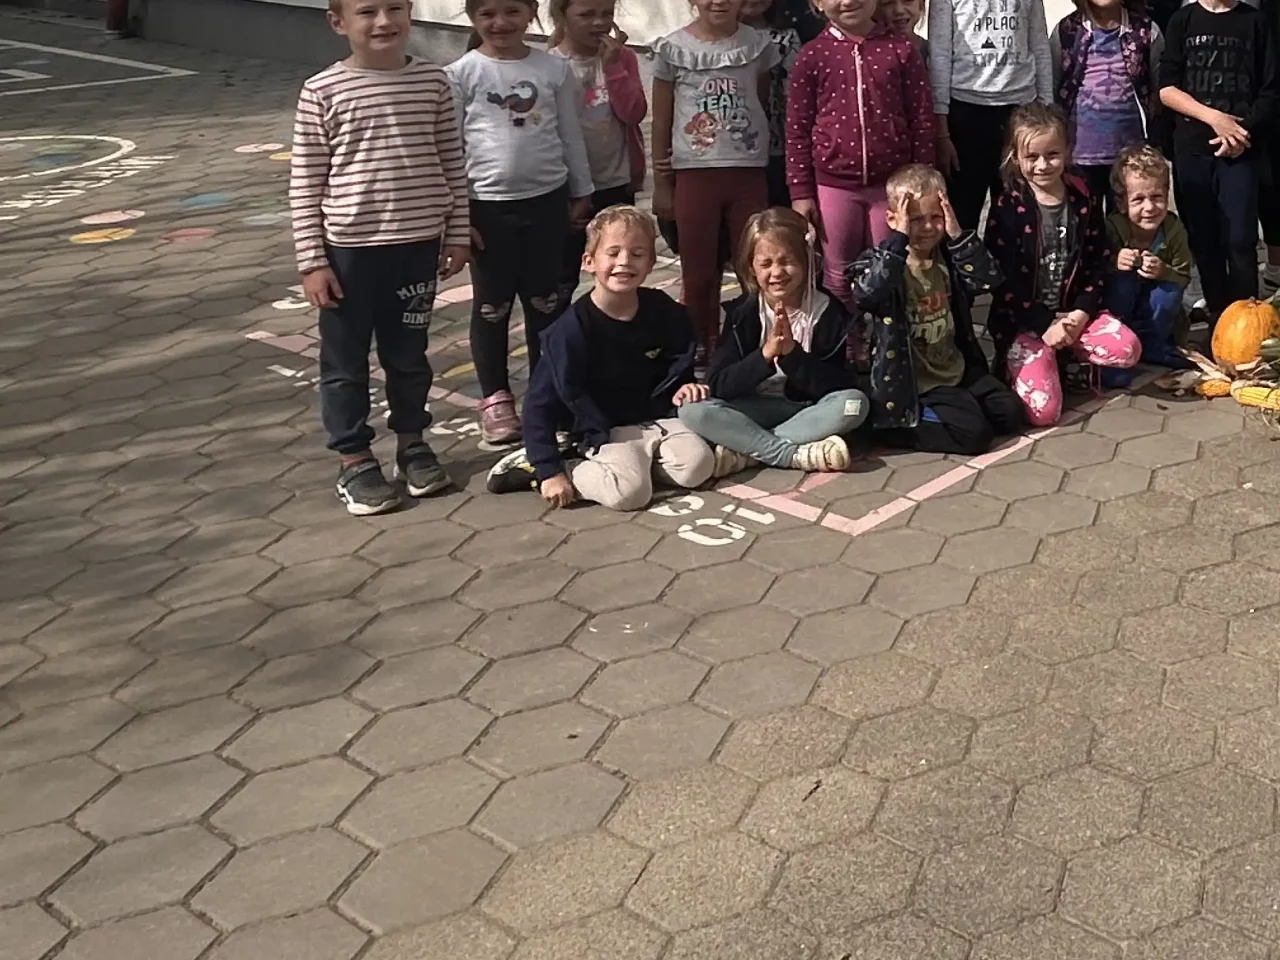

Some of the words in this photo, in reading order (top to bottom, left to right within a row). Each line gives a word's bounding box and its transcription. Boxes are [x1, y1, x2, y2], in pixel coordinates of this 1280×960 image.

[973, 18, 982, 31] A
[1001, 36, 1014, 48] TO
[704, 78, 738, 95] ONE
[1186, 70, 1250, 93] SUPER
[696, 93, 745, 113] TEAM
